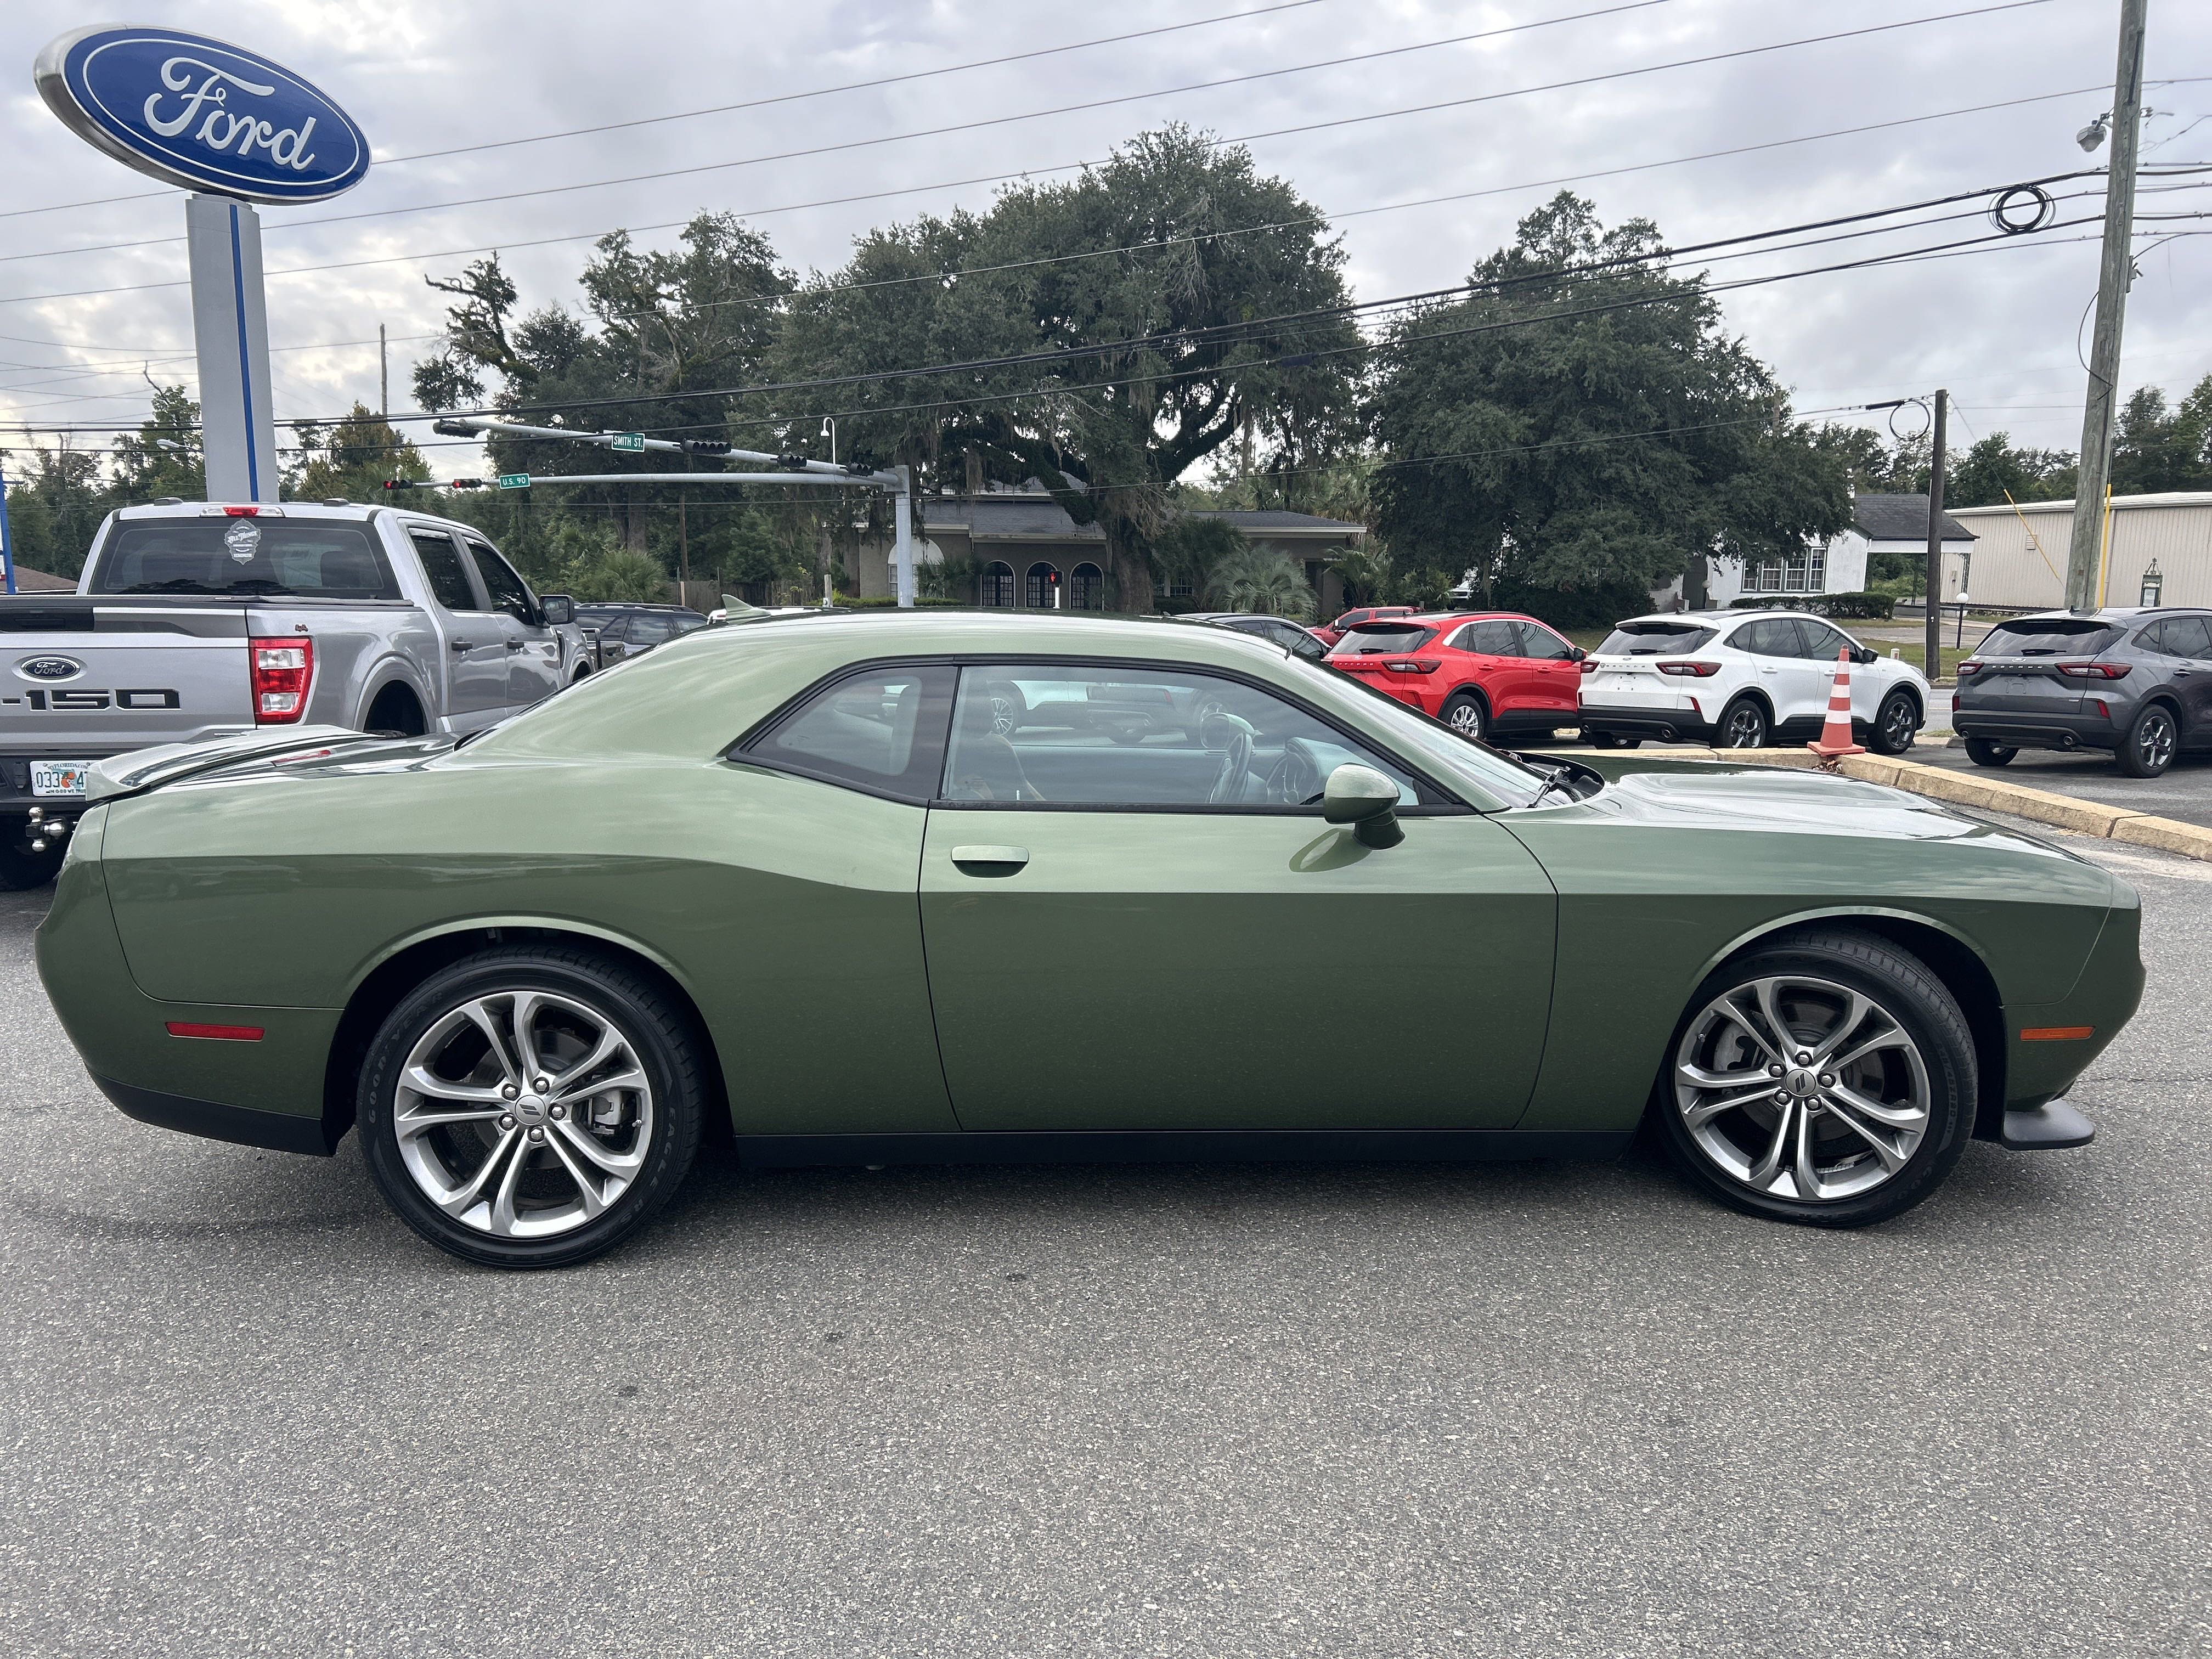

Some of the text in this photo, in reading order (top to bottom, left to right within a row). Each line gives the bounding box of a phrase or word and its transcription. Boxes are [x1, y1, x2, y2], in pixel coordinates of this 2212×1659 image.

[144, 57, 316, 170] Ford
[614, 436, 642, 447] SMITH ST.
[34, 662, 65, 675] Ford
[36, 771, 60, 788] 033
[650, 1107, 676, 1190] EAGLE
